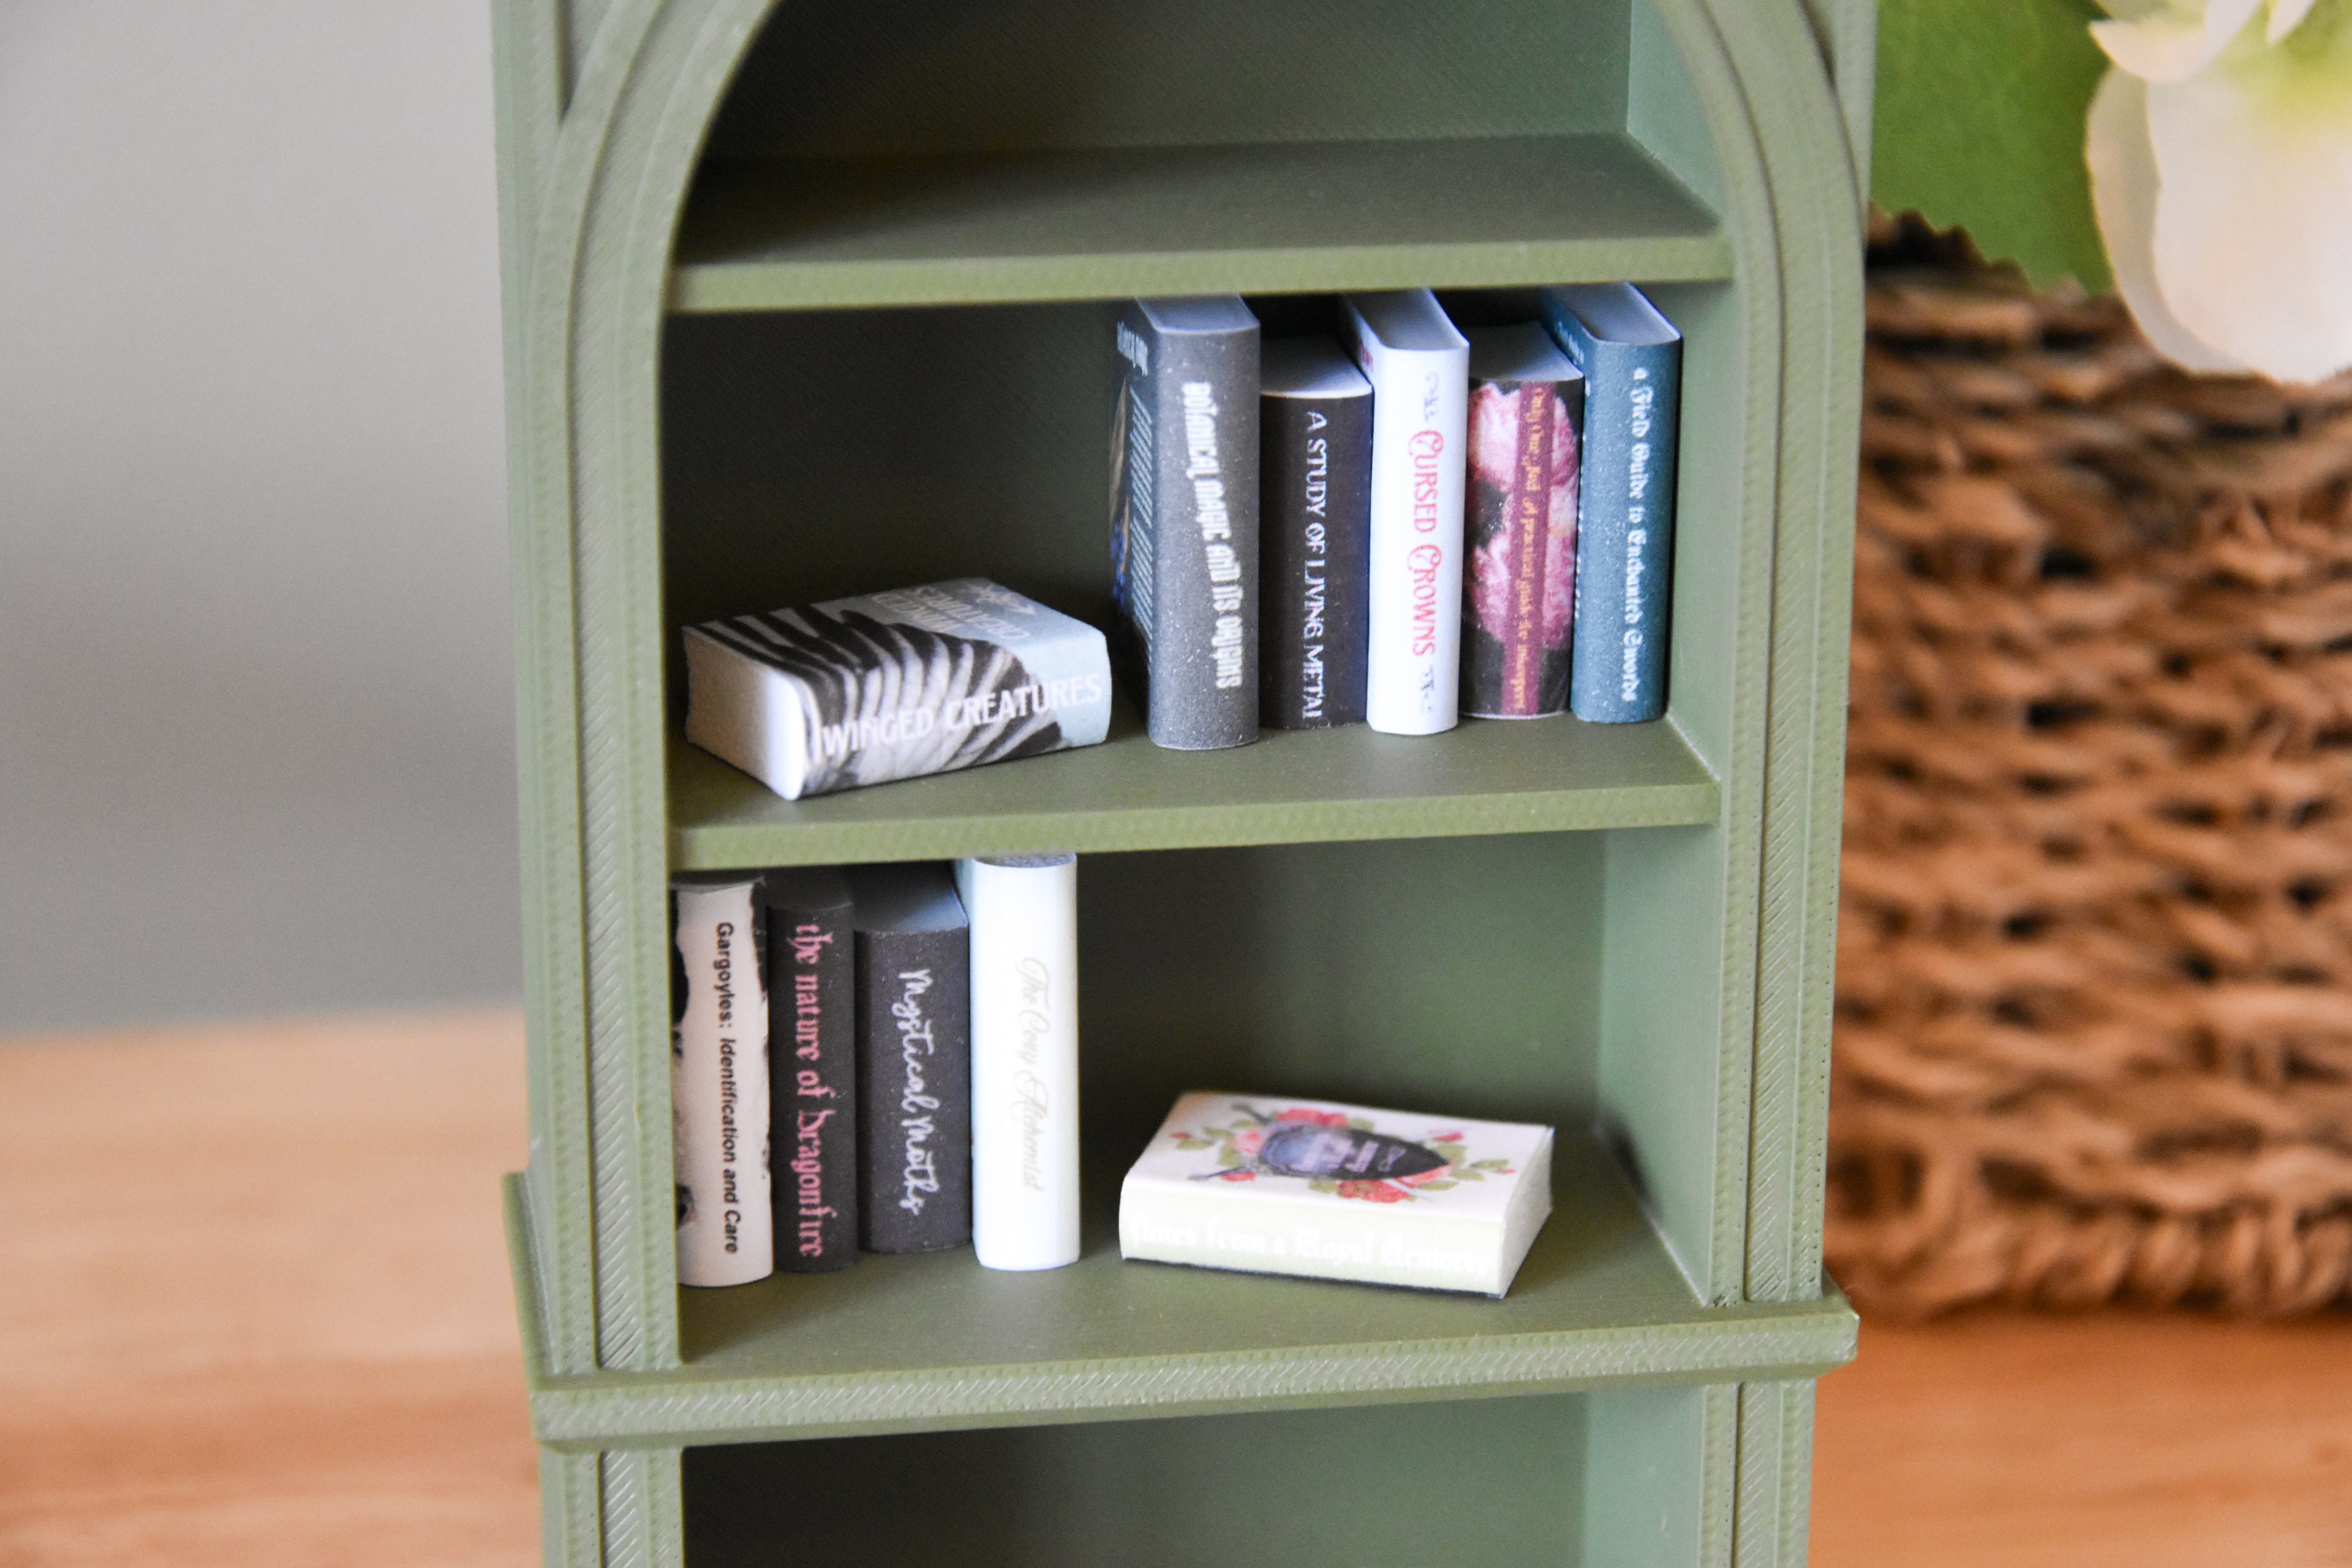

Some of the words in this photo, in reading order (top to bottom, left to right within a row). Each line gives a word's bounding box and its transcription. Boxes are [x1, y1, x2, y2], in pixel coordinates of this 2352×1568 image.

[1182, 381, 1220, 480] BOTANICAL
[1306, 410, 1328, 430] A
[1305, 437, 1328, 518] STUDY
[1408, 429, 1444, 535] CURSED
[1629, 441, 1651, 500] Guide
[1194, 479, 1232, 541] MAGIC
[1303, 522, 1326, 554] OF
[1628, 504, 1648, 524] to
[1206, 543, 1242, 582] AND
[1212, 584, 1243, 612] ITS
[1303, 559, 1326, 639] LIVING
[1624, 528, 1648, 625] Enchanted
[1407, 544, 1442, 658] CROWNS
[1210, 614, 1243, 689] ORIGINS
[1621, 628, 1645, 703] Swords
[821, 707, 936, 756] WINGED
[944, 675, 1102, 732] CREATURES
[713, 922, 735, 1028] Gargoyles:
[786, 924, 833, 965] the
[796, 974, 821, 1061] nature
[892, 968, 940, 1112] Mystical
[719, 1036, 737, 1163] Identification
[796, 1069, 837, 1099] of
[723, 1167, 739, 1205] and
[898, 1115, 940, 1217] Moths
[723, 1210, 741, 1254] Care
